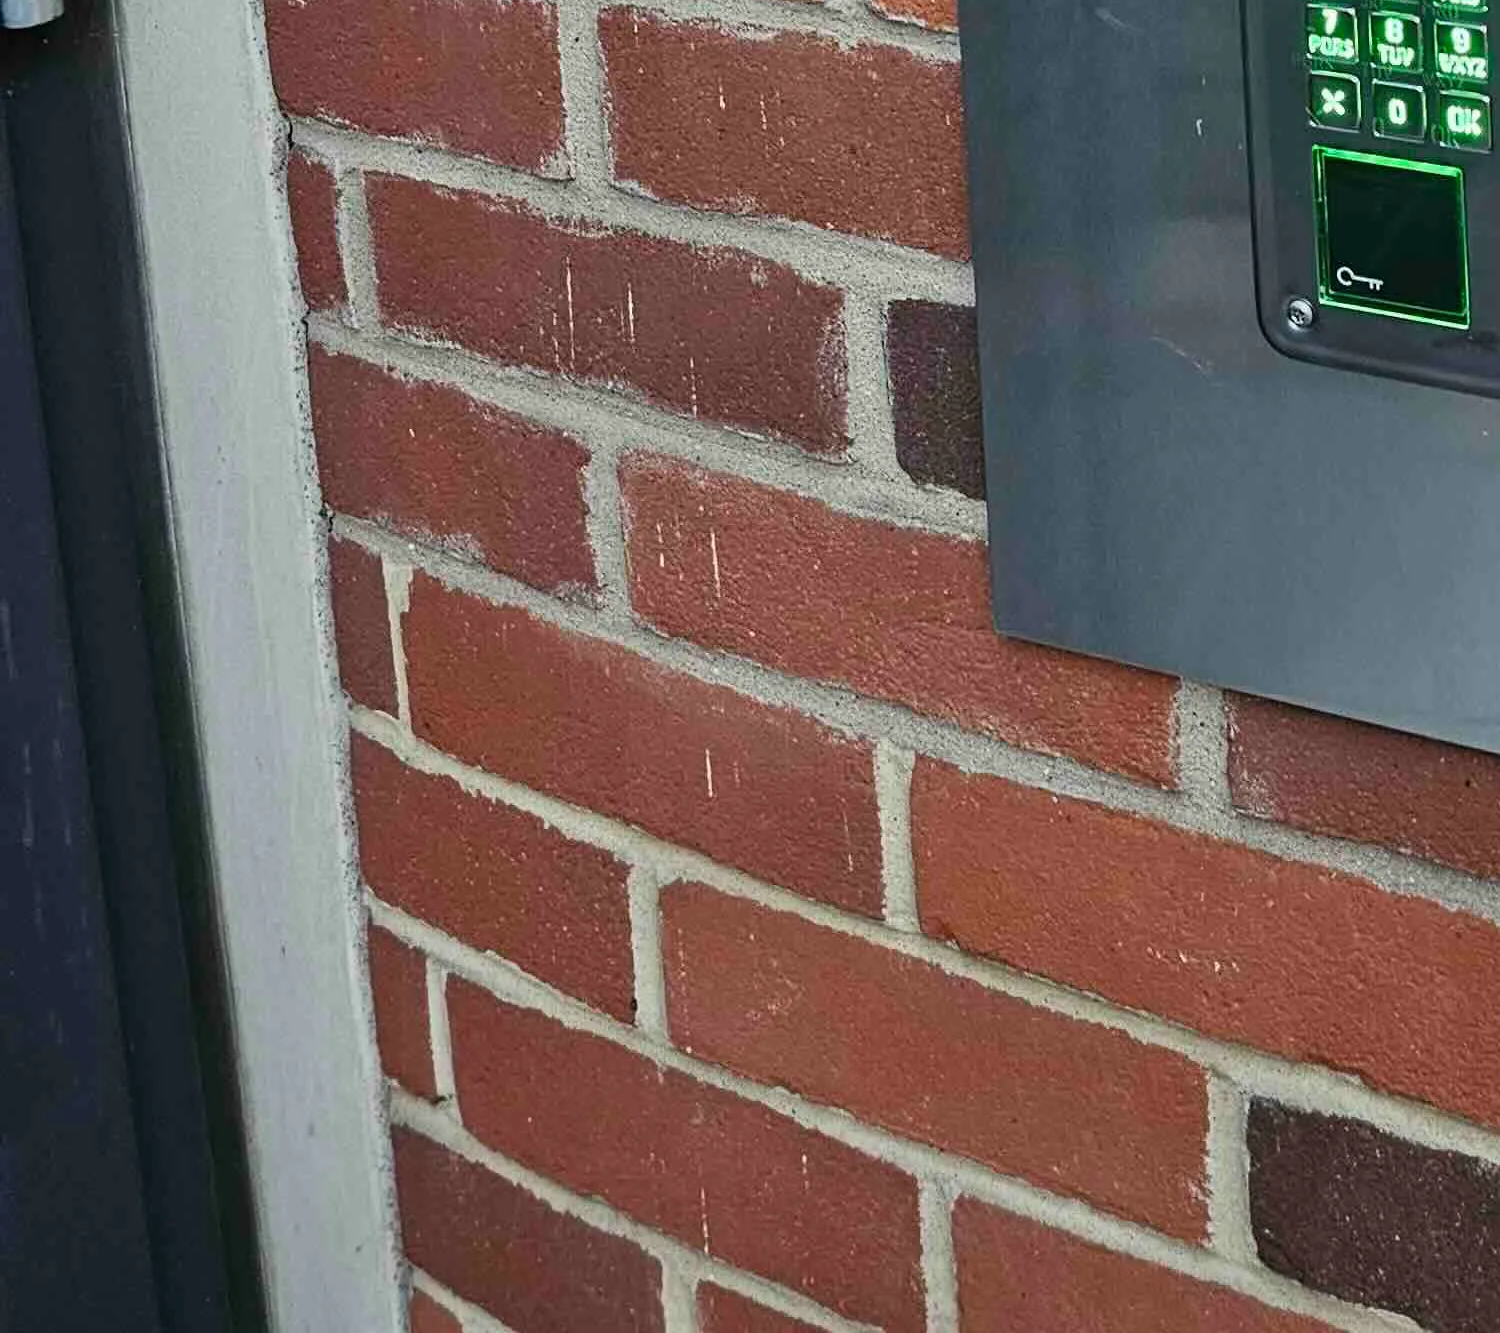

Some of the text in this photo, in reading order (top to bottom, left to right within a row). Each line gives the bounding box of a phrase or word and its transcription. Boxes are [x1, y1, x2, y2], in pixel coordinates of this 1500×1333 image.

[1321, 8, 1338, 35] 7
[1384, 17, 1404, 44] 8
[1451, 27, 1472, 54] 9
[1376, 43, 1416, 67] TUV
[1446, 105, 1482, 136] OK
